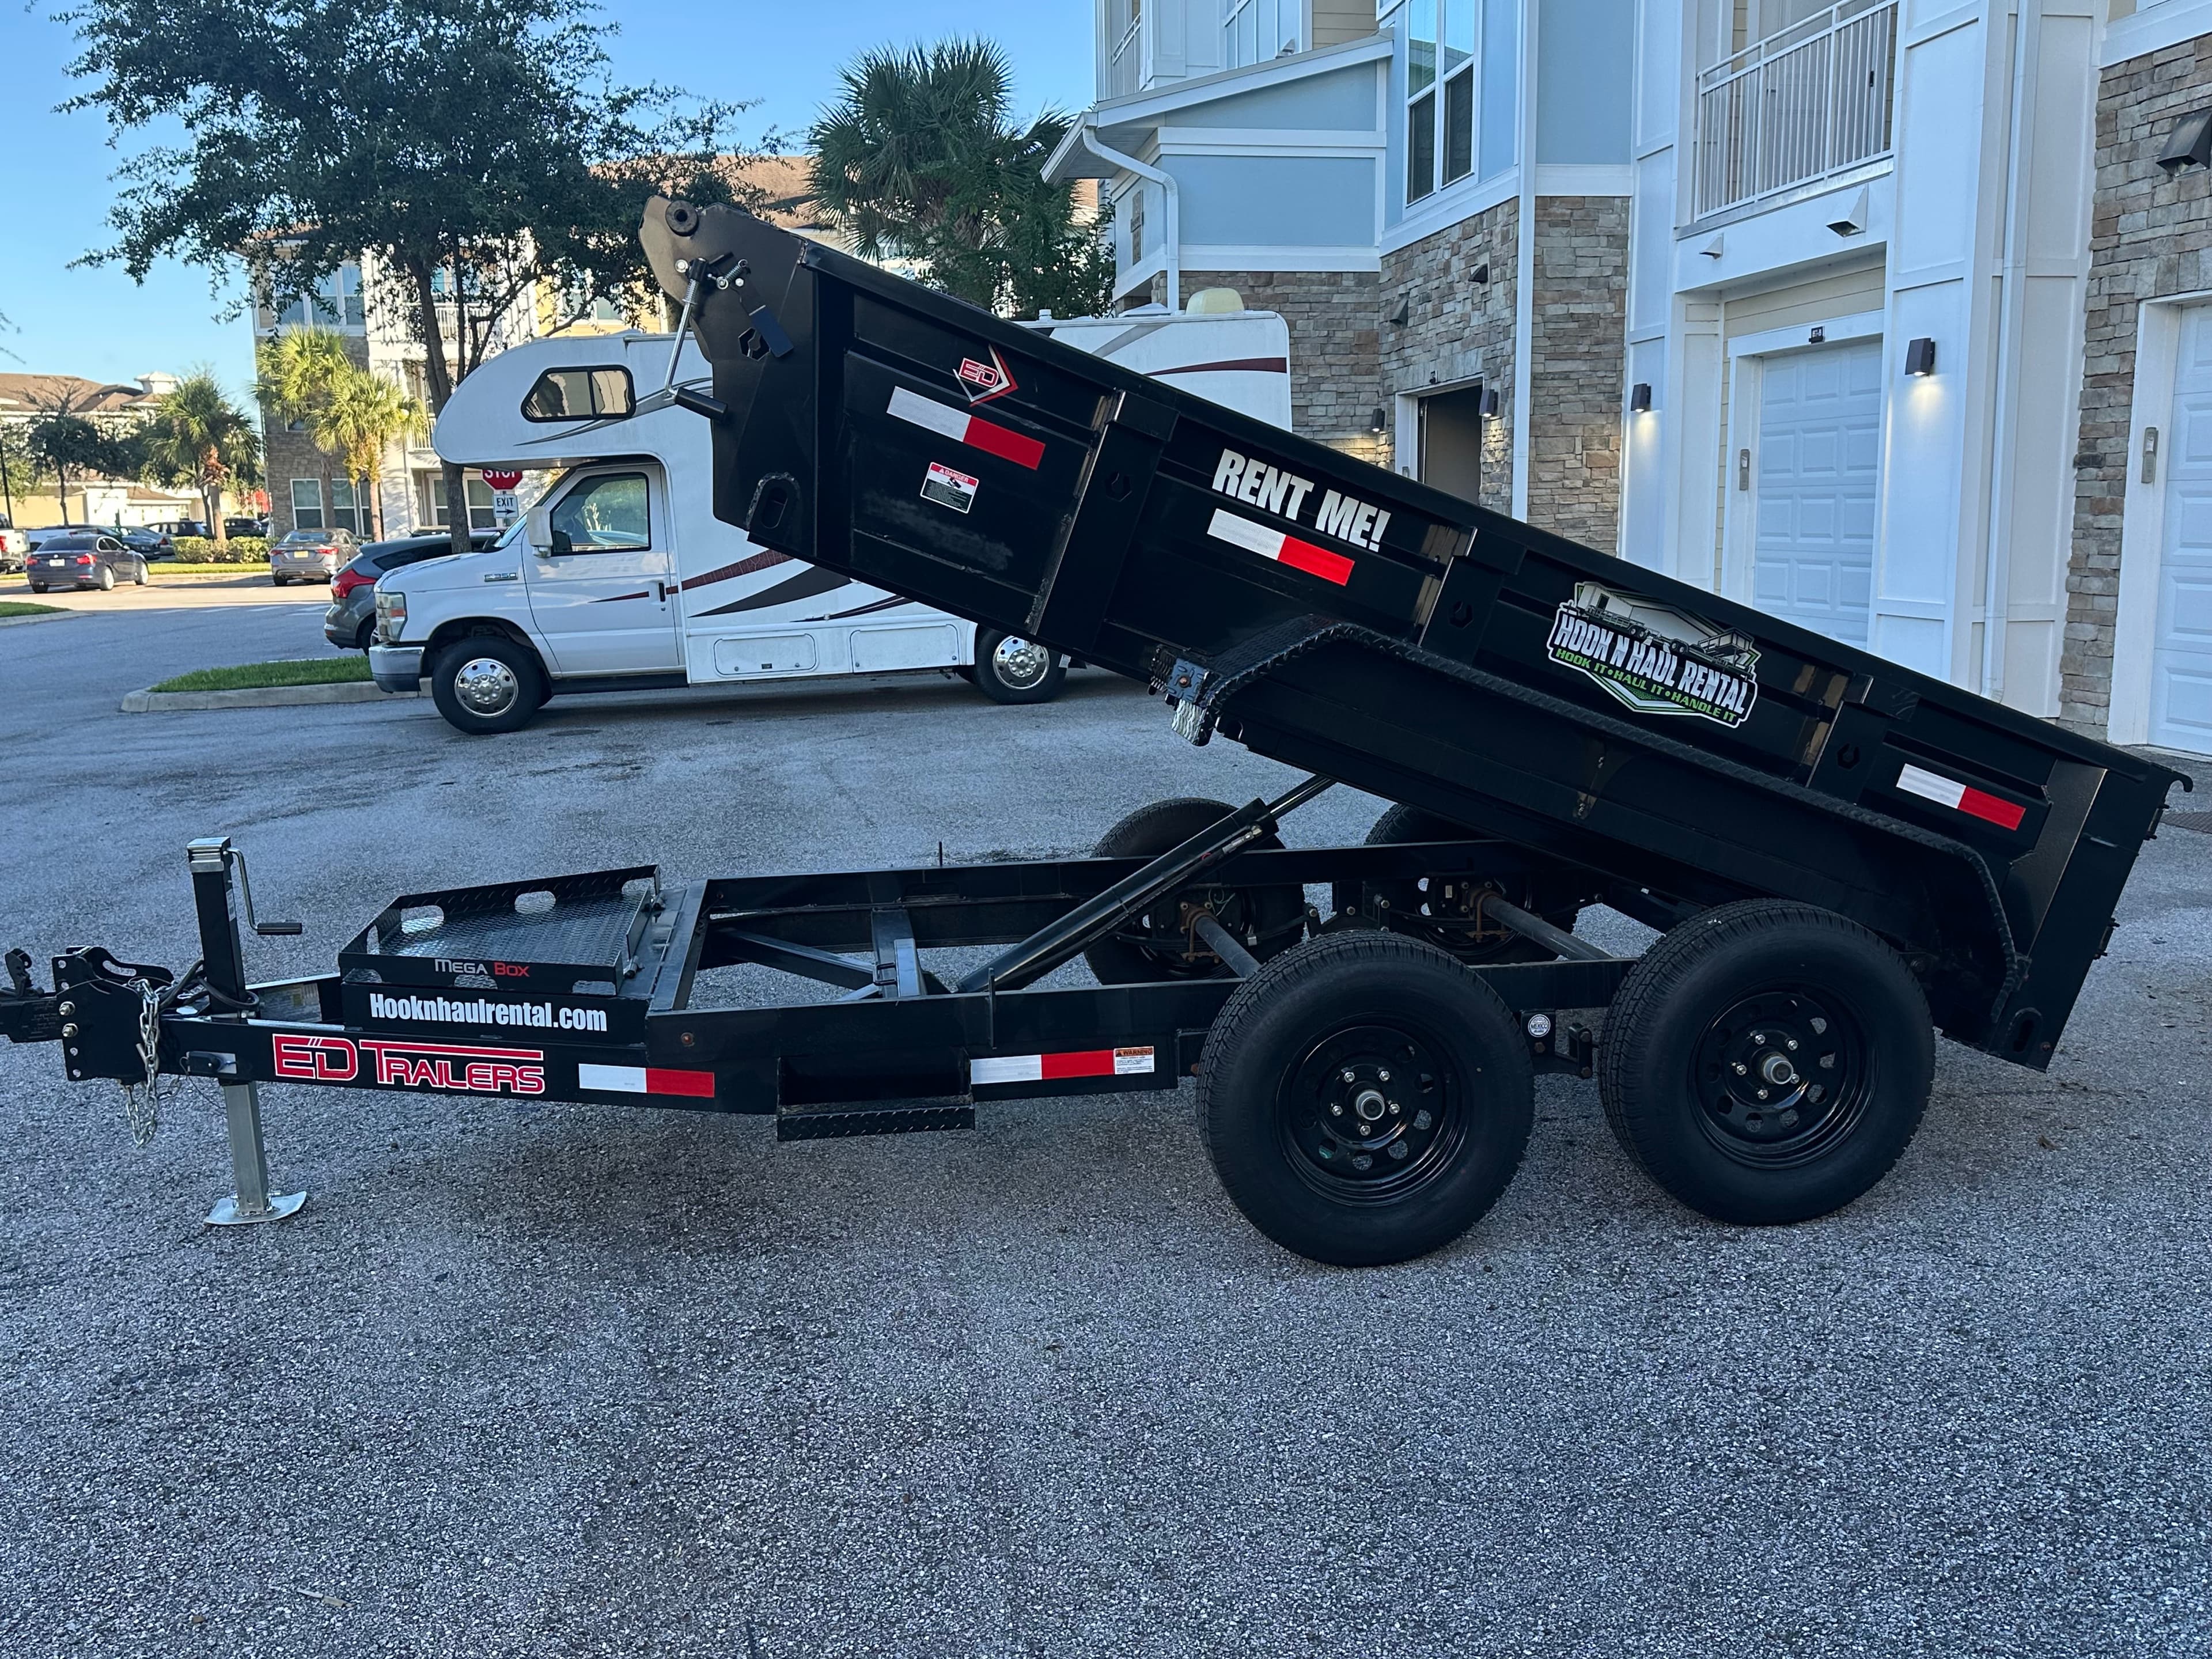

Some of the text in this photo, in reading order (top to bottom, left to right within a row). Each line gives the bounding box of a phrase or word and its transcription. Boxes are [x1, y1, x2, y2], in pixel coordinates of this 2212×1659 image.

[945, 469, 969, 483] DANGER
[497, 498, 514, 507] EXIT
[1212, 449, 1392, 552] RENT ME!
[1554, 613, 1748, 714] HOOK N HAUL RENTAL
[1556, 649, 1592, 669] HOOK
[1723, 711, 1737, 722] IT
[369, 993, 608, 1032] Hooknhaulrental.com
[272, 1033, 358, 1081] ED
[1123, 1048, 1153, 1056] WARNING
